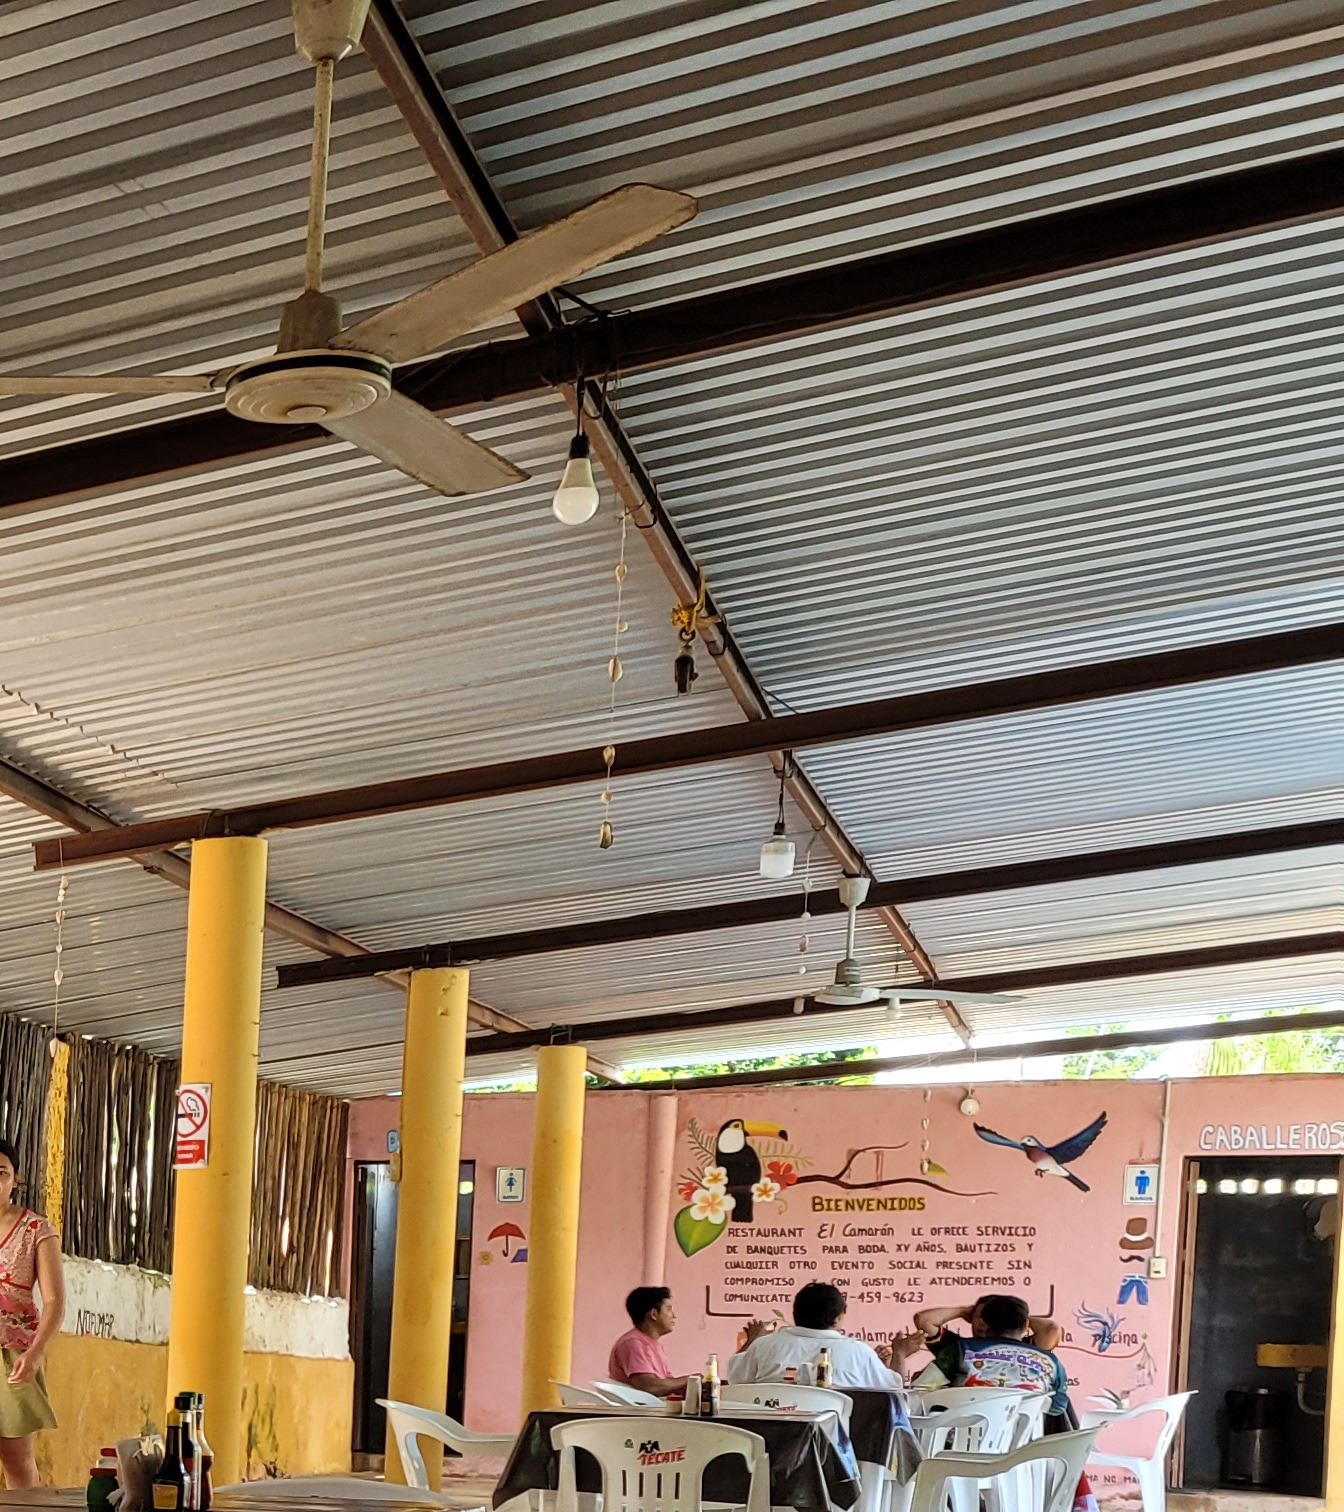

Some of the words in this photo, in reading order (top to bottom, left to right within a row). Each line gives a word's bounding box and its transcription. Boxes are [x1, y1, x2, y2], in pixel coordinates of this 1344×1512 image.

[1199, 1121, 1344, 1150] CABALLEROS
[812, 1196, 925, 1212] BIENVENIDOS
[728, 1227, 805, 1238] RESTAURANT
[817, 1223, 835, 1239] El
[843, 1223, 894, 1237] Camarón
[912, 1227, 923, 1236] LE
[930, 1226, 969, 1236] OFRECE
[976, 1226, 1036, 1237] SERVICIO
[726, 1245, 738, 1254] DE
[746, 1245, 807, 1255] BANQUETES
[822, 1245, 849, 1254] PARA
[896, 1243, 910, 1252] XV
[956, 1243, 1016, 1253] BAUTIZOS
[1027, 1242, 1034, 1252] Y
[725, 1260, 778, 1270] CUALQUIER
[789, 1260, 817, 1270] OTRO
[831, 1260, 874, 1270] EVENTO
[889, 1260, 927, 1270] SOCIAL
[936, 1260, 993, 1270] PRESENTE
[1007, 1260, 1032, 1270] SIN
[724, 1277, 795, 1287] COMPROMISO
[831, 1277, 850, 1286] CON
[862, 1277, 894, 1287] GUSTO
[908, 1277, 921, 1286] LE
[930, 1276, 1015, 1286] ATENDEREMOS
[1023, 1276, 1031, 1286] O
[724, 1293, 792, 1303] COMUNICATE
[841, 1291, 924, 1303] 9-459-9623
[1061, 1327, 1073, 1342] la
[637, 1449, 686, 1466] TECATE
